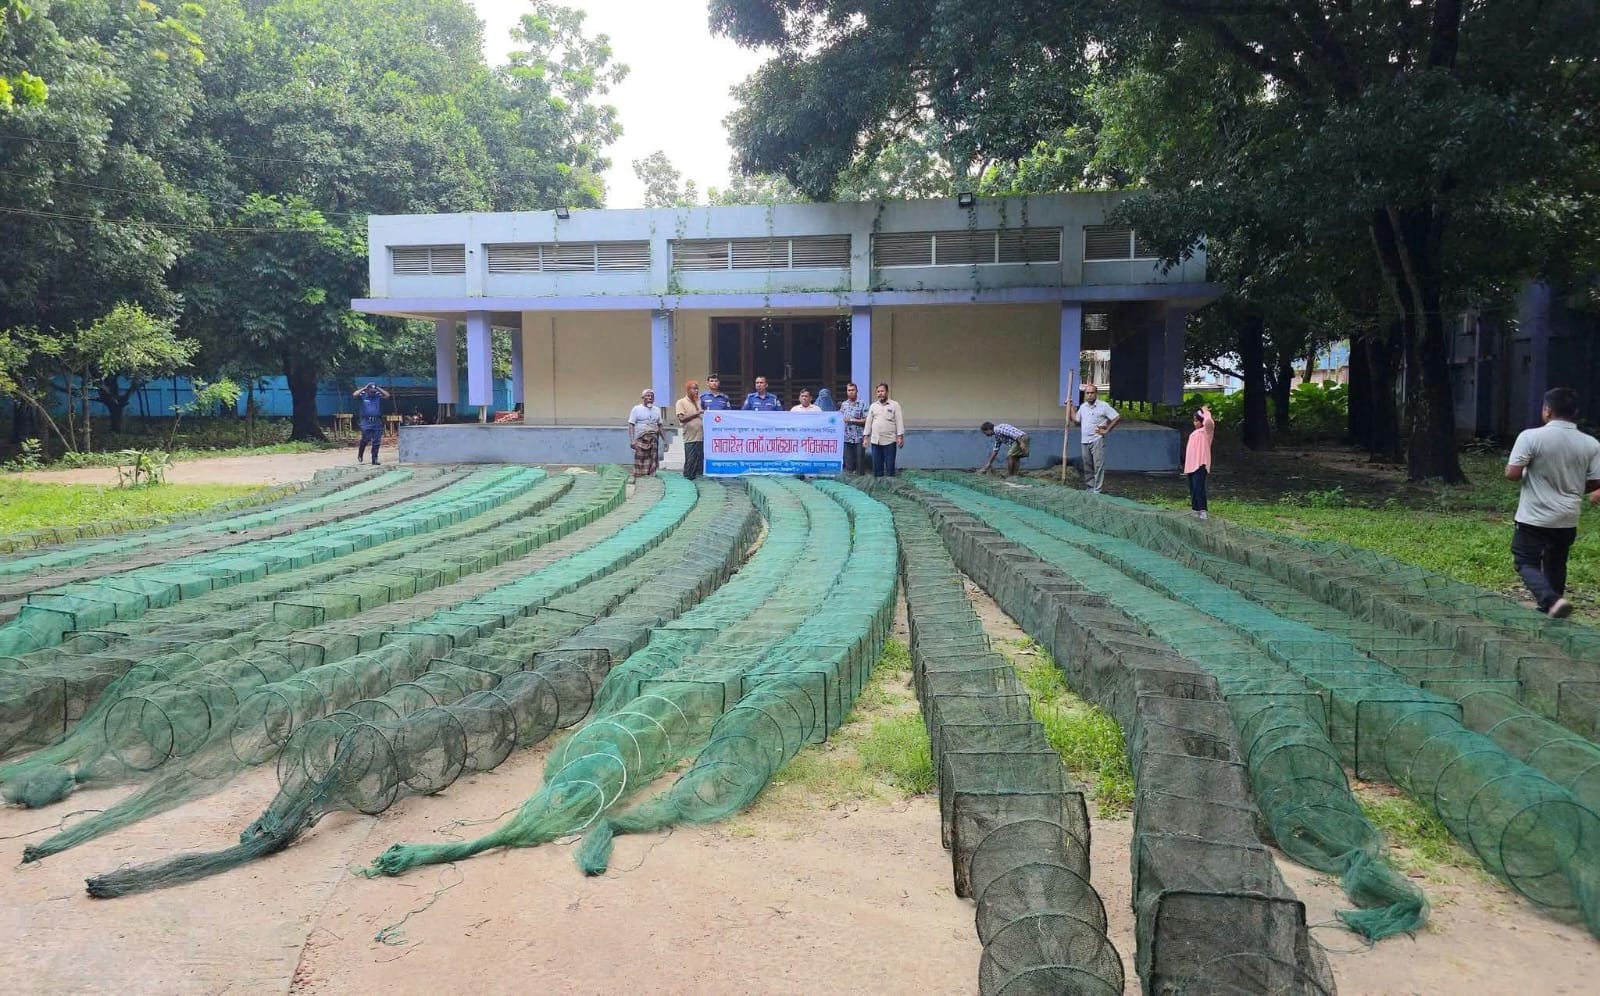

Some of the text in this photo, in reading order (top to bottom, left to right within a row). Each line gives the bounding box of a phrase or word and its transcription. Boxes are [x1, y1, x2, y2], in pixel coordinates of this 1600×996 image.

[746, 435, 763, 453] কোর্ট
[765, 437, 798, 454] অভিযান
[801, 437, 837, 456] পরিচালনা
